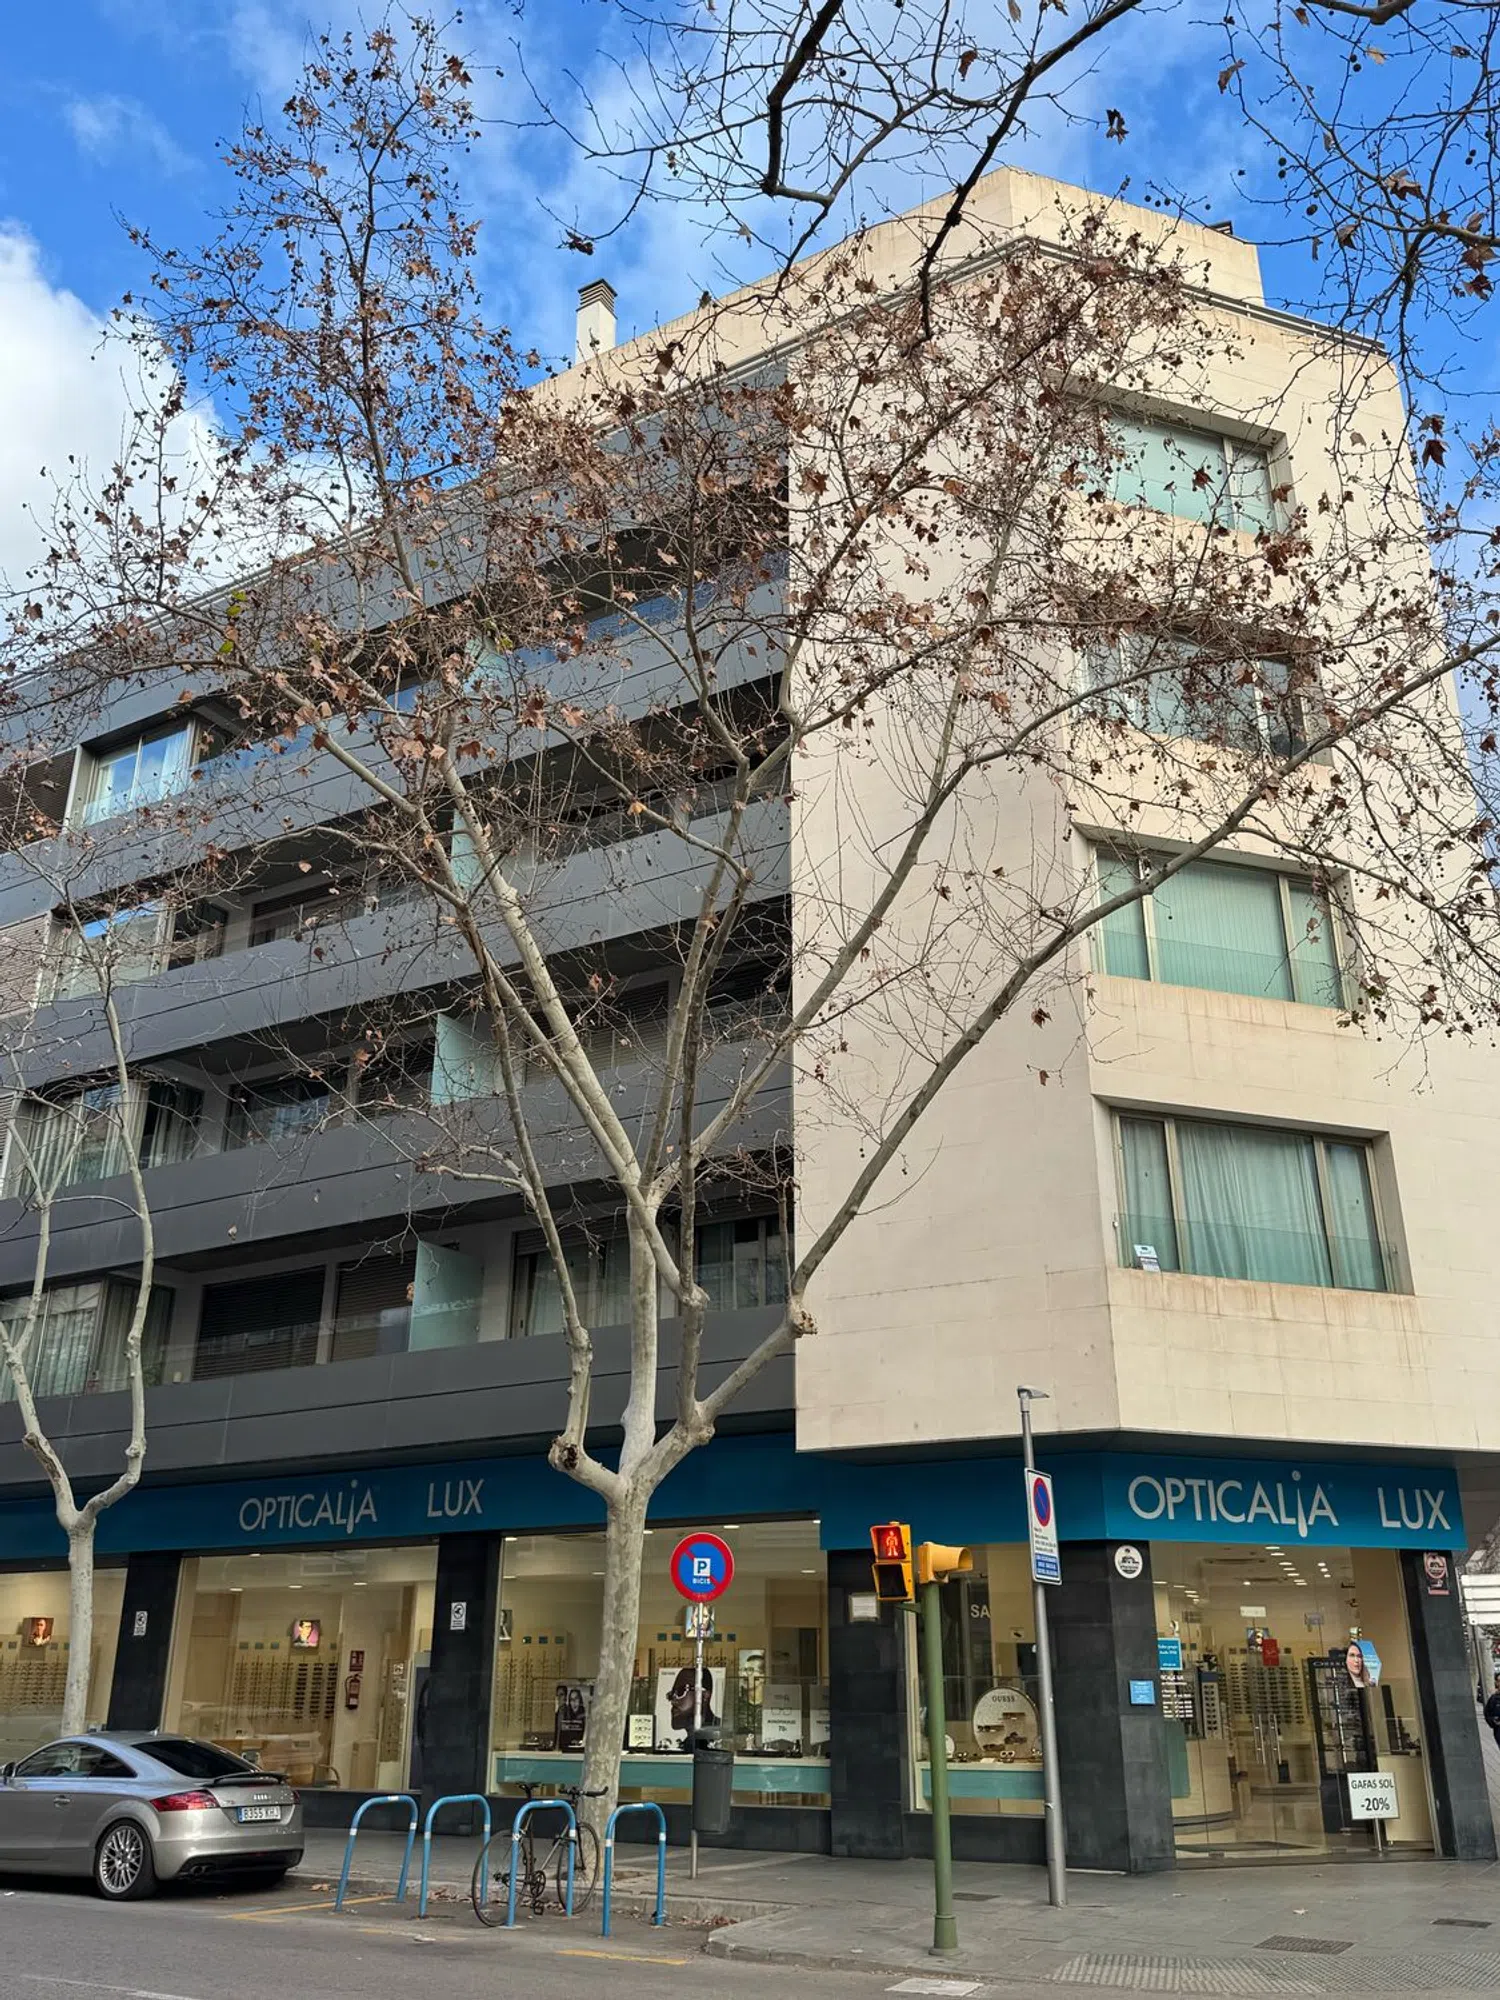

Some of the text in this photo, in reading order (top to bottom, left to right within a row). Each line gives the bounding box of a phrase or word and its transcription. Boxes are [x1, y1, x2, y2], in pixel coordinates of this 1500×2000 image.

[427, 1479, 484, 1517] LUX
[1377, 1486, 1451, 1530] LUX
[697, 1560, 707, 1574] P
[992, 1695, 1015, 1703] GUESS
[1351, 1779, 1394, 1789] GAFAS SOL
[1361, 1797, 1391, 1811] -20%
